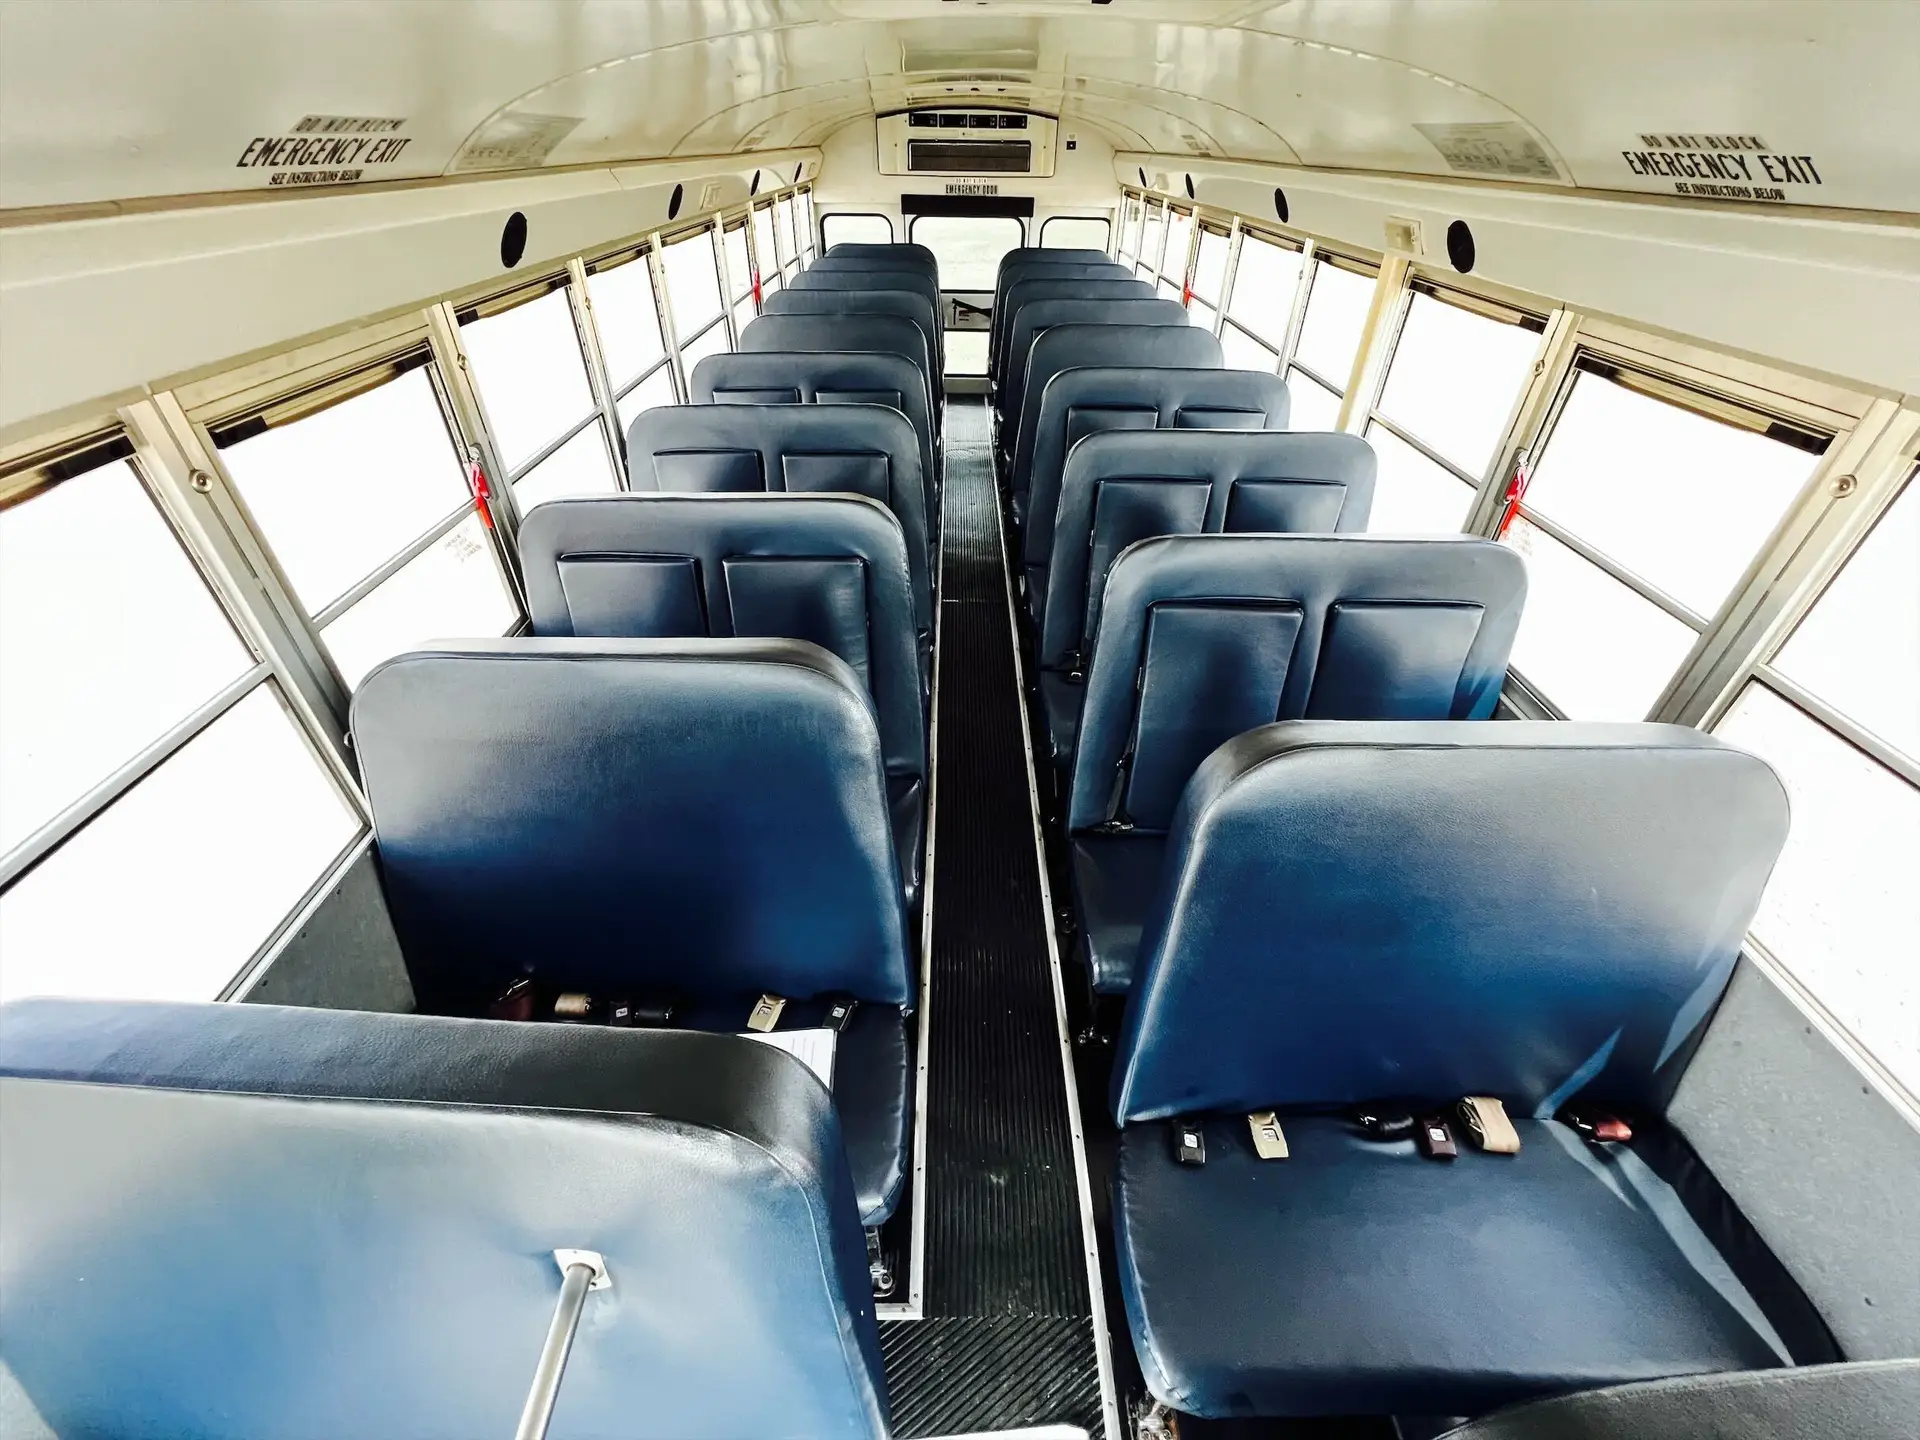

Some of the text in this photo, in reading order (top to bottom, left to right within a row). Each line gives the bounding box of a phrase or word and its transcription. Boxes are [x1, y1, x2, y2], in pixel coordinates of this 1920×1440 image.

[1641, 135, 1765, 150] DO NOT BLOCK
[236, 137, 412, 167] EMERGENCY EXIT
[1622, 151, 1822, 184] EMERGENCY EXIT
[269, 172, 287, 185] SEE
[286, 171, 340, 184] INSTRUCTIONS
[945, 184, 980, 194] EMERGENCY
[1675, 182, 1785, 200] SEE INSTRUCTIONS BELOW
